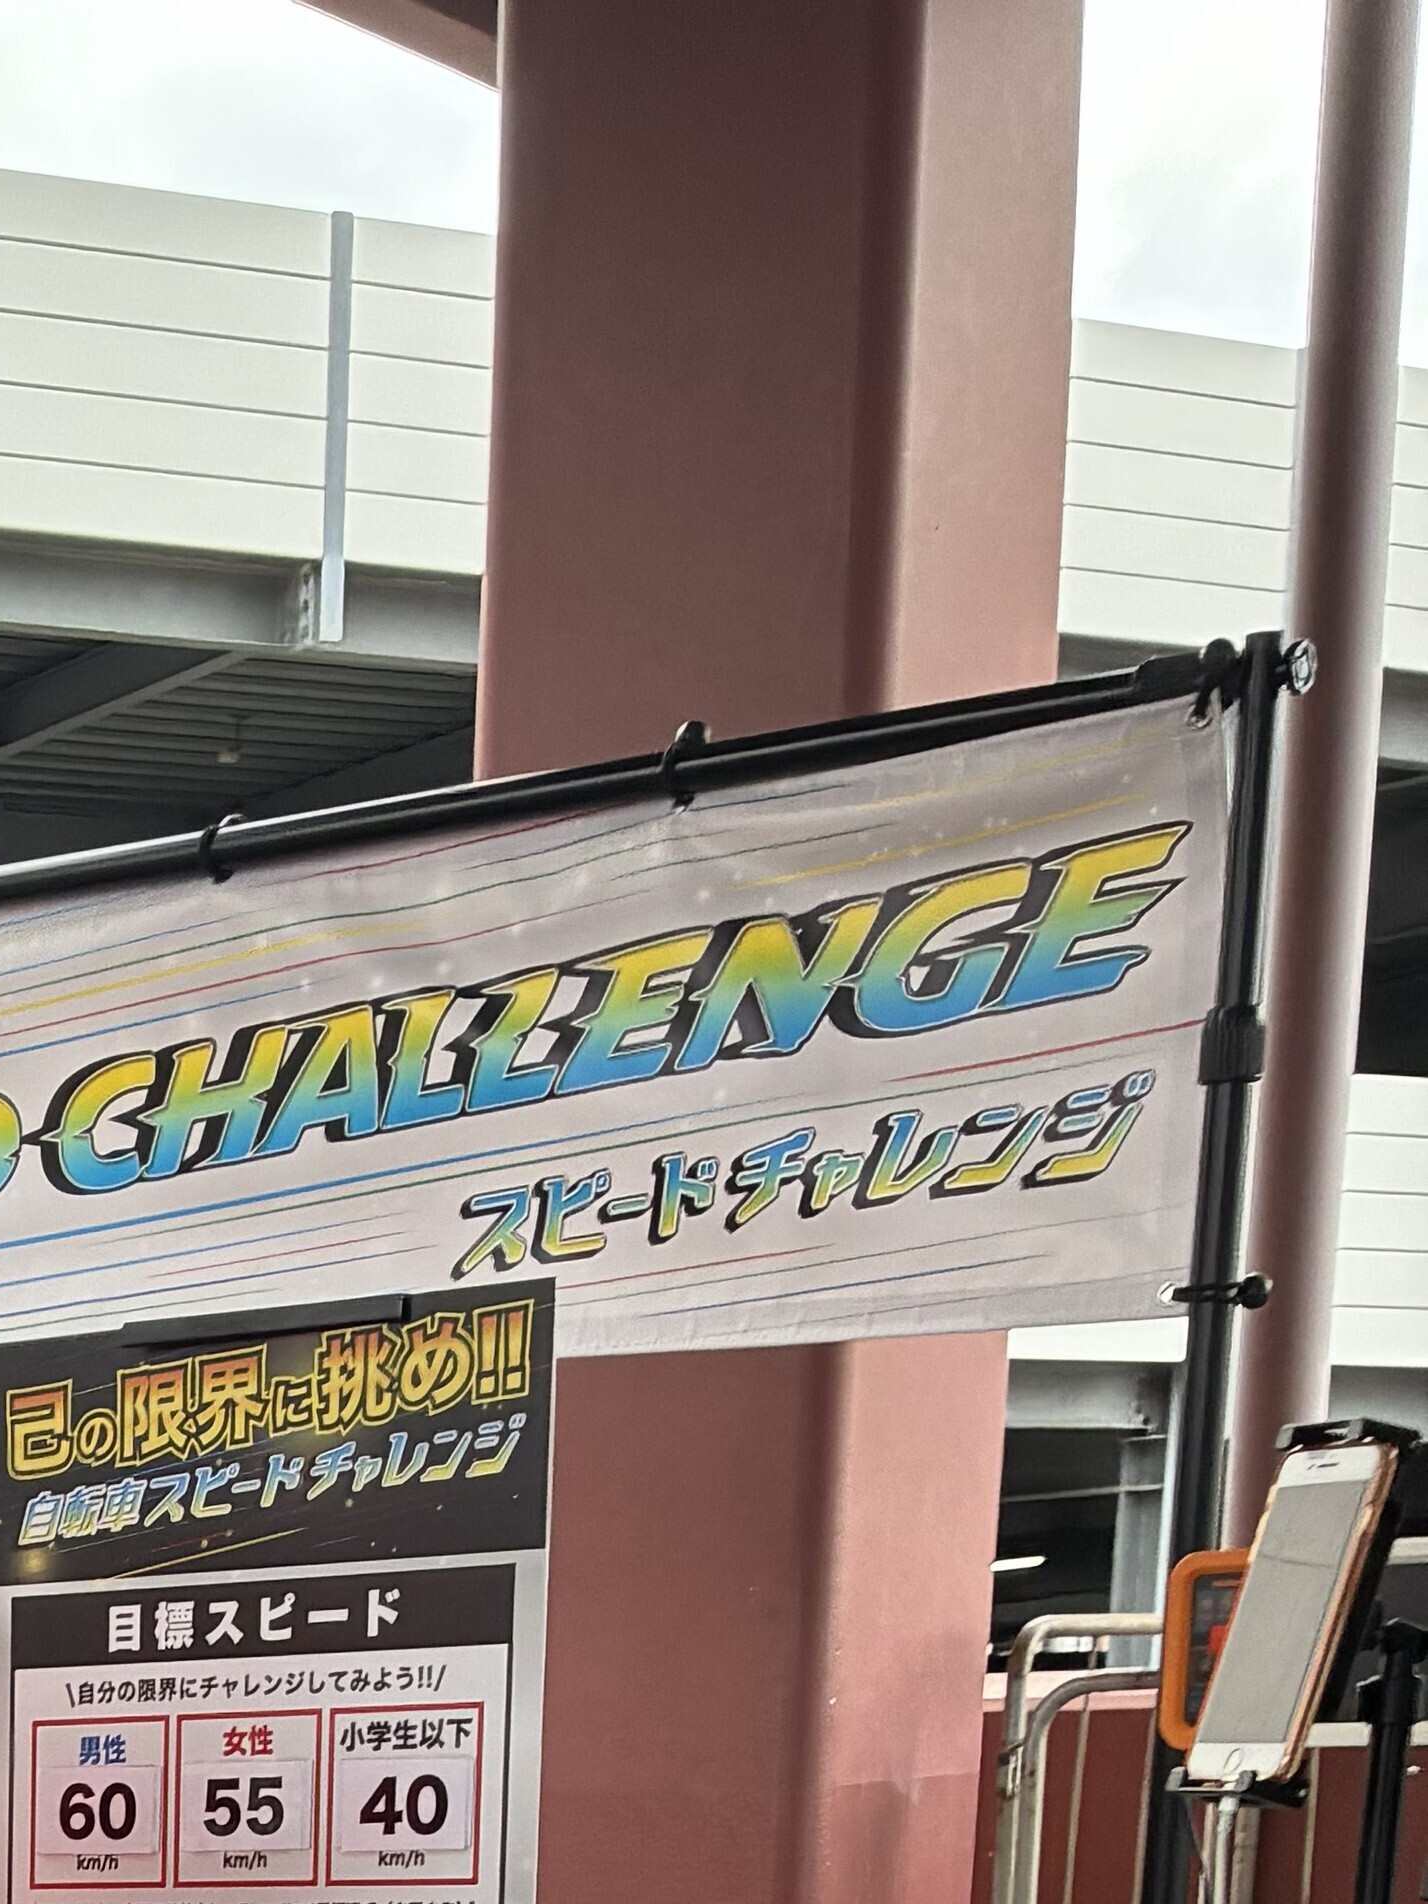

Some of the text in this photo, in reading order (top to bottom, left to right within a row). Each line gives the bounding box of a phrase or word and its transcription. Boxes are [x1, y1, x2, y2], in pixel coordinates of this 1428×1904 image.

[31, 821, 1194, 1195] CHALLENGE
[450, 1070, 1156, 1279] スピードチャレンジ
[18, 1411, 527, 1546] 自転車スピードチャレンジ
[107, 1589, 401, 1653] 目標スピード
[78, 1735, 126, 1765] 男性
[223, 1726, 274, 1757] 女性
[339, 1718, 474, 1753] 小学生以下
[59, 1781, 137, 1841] 60
[203, 1776, 285, 1836] 55
[359, 1775, 449, 1836] 40
[76, 1852, 119, 1872] km/h
[222, 1850, 268, 1871] km/h
[377, 1849, 425, 1869] km/h
